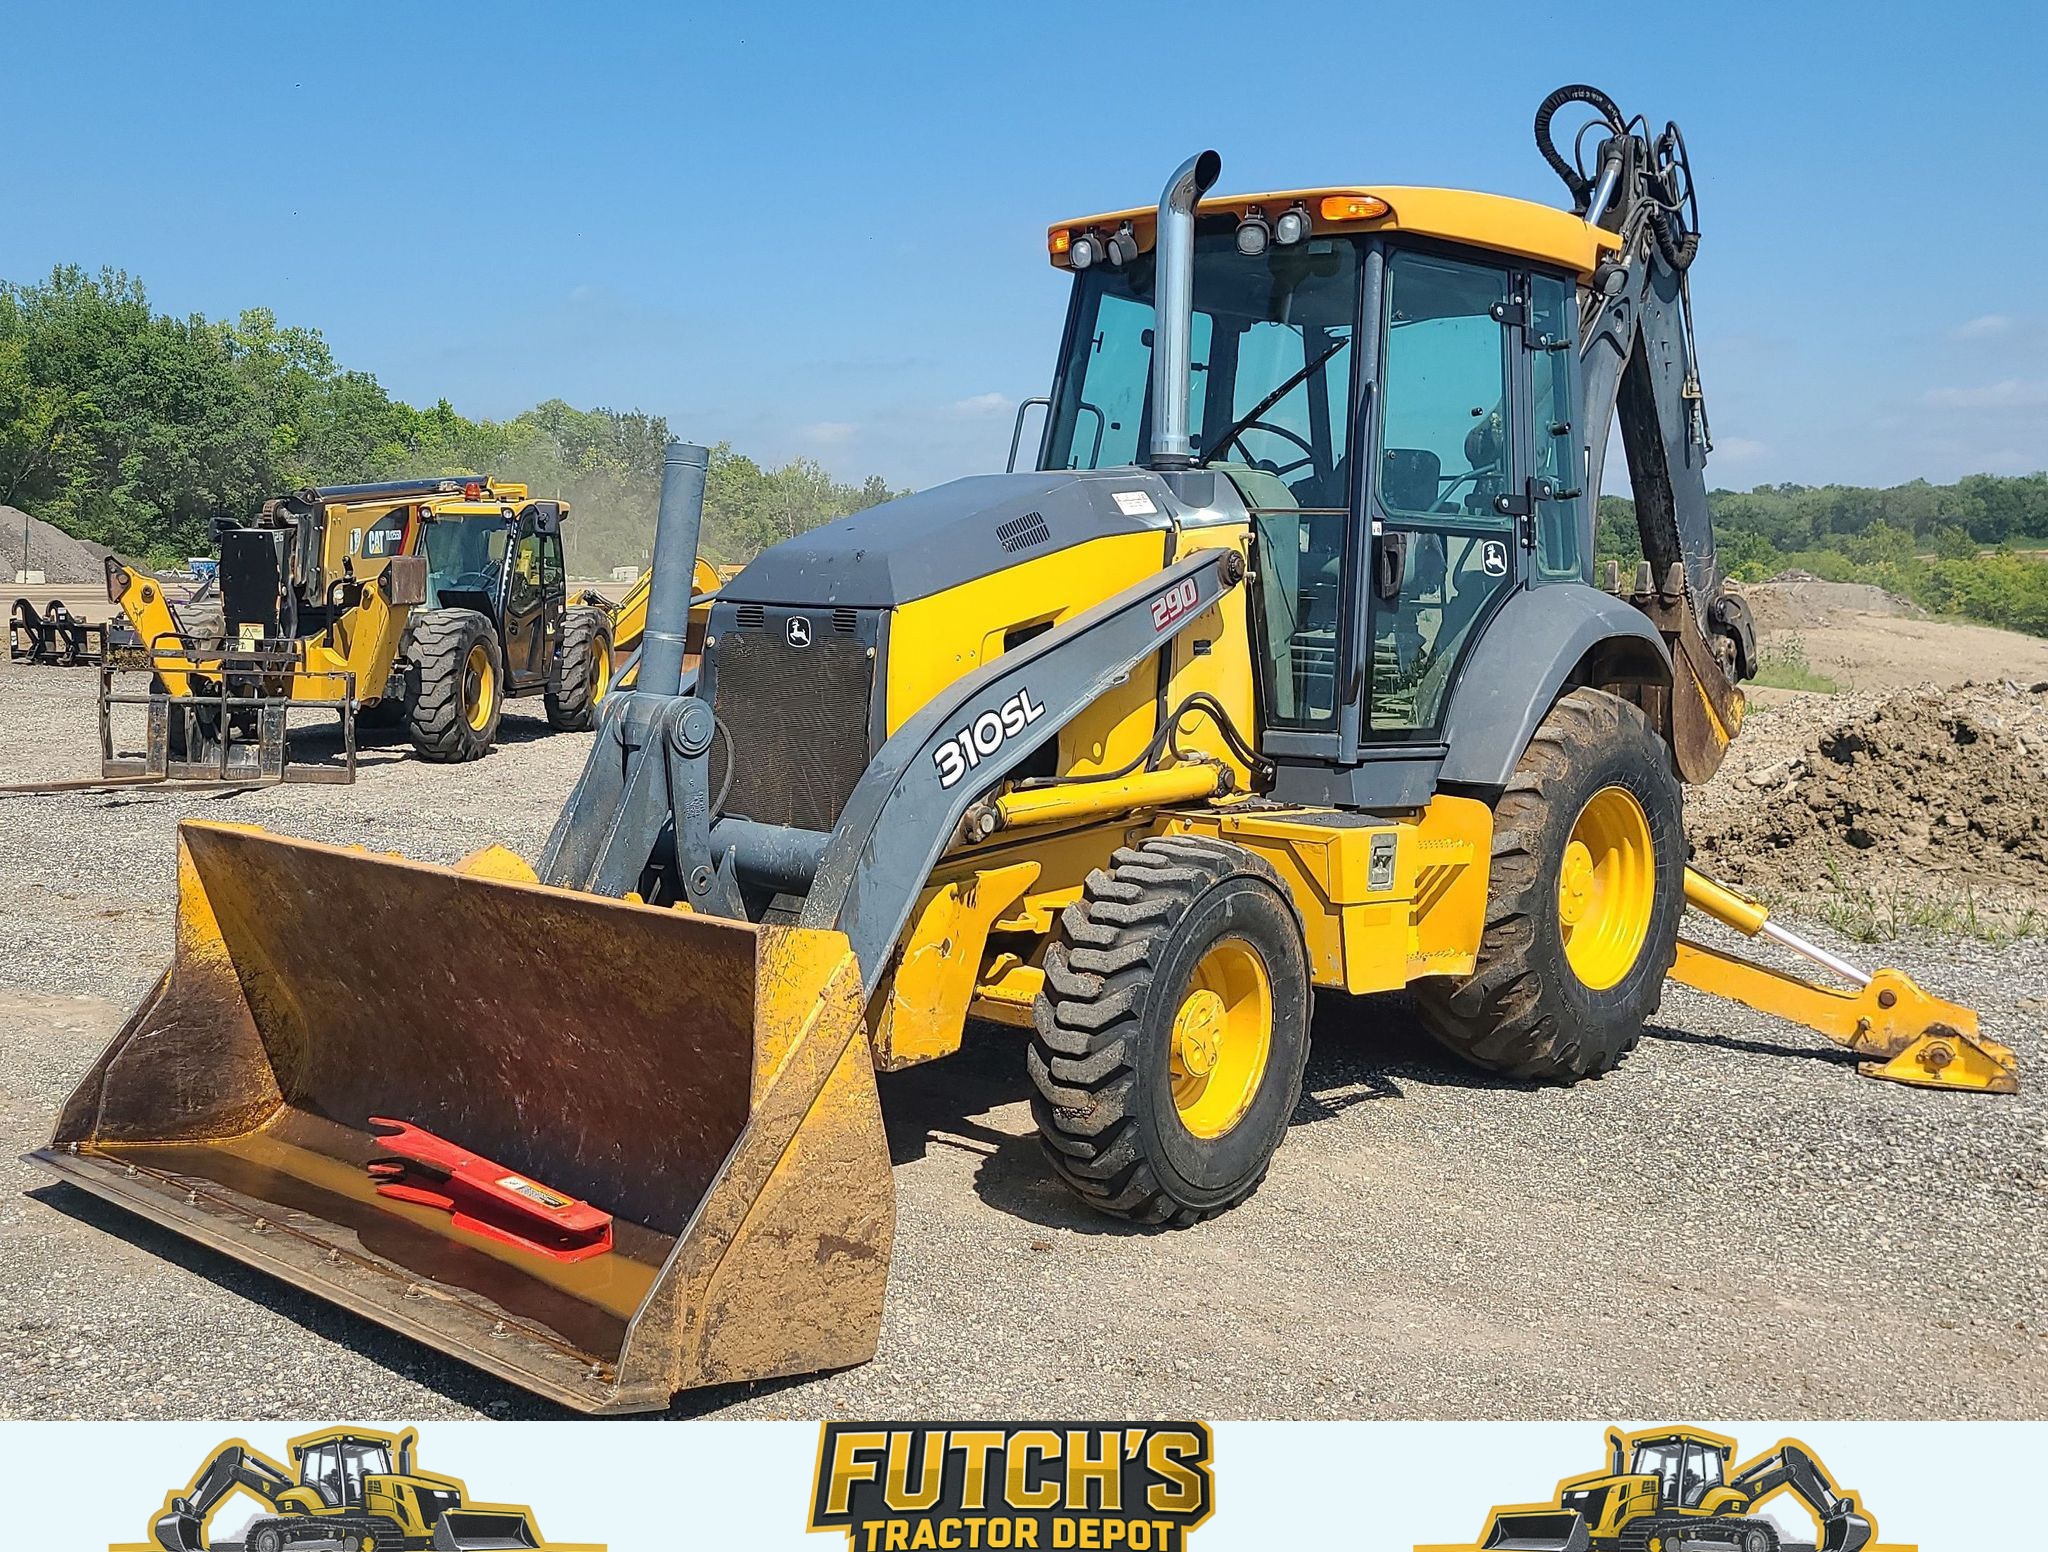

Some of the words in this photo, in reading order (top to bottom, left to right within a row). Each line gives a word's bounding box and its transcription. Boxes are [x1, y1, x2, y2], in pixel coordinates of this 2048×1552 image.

[368, 530, 385, 555] CAT
[1151, 578, 1199, 632] 290
[931, 686, 1046, 790] 310SL
